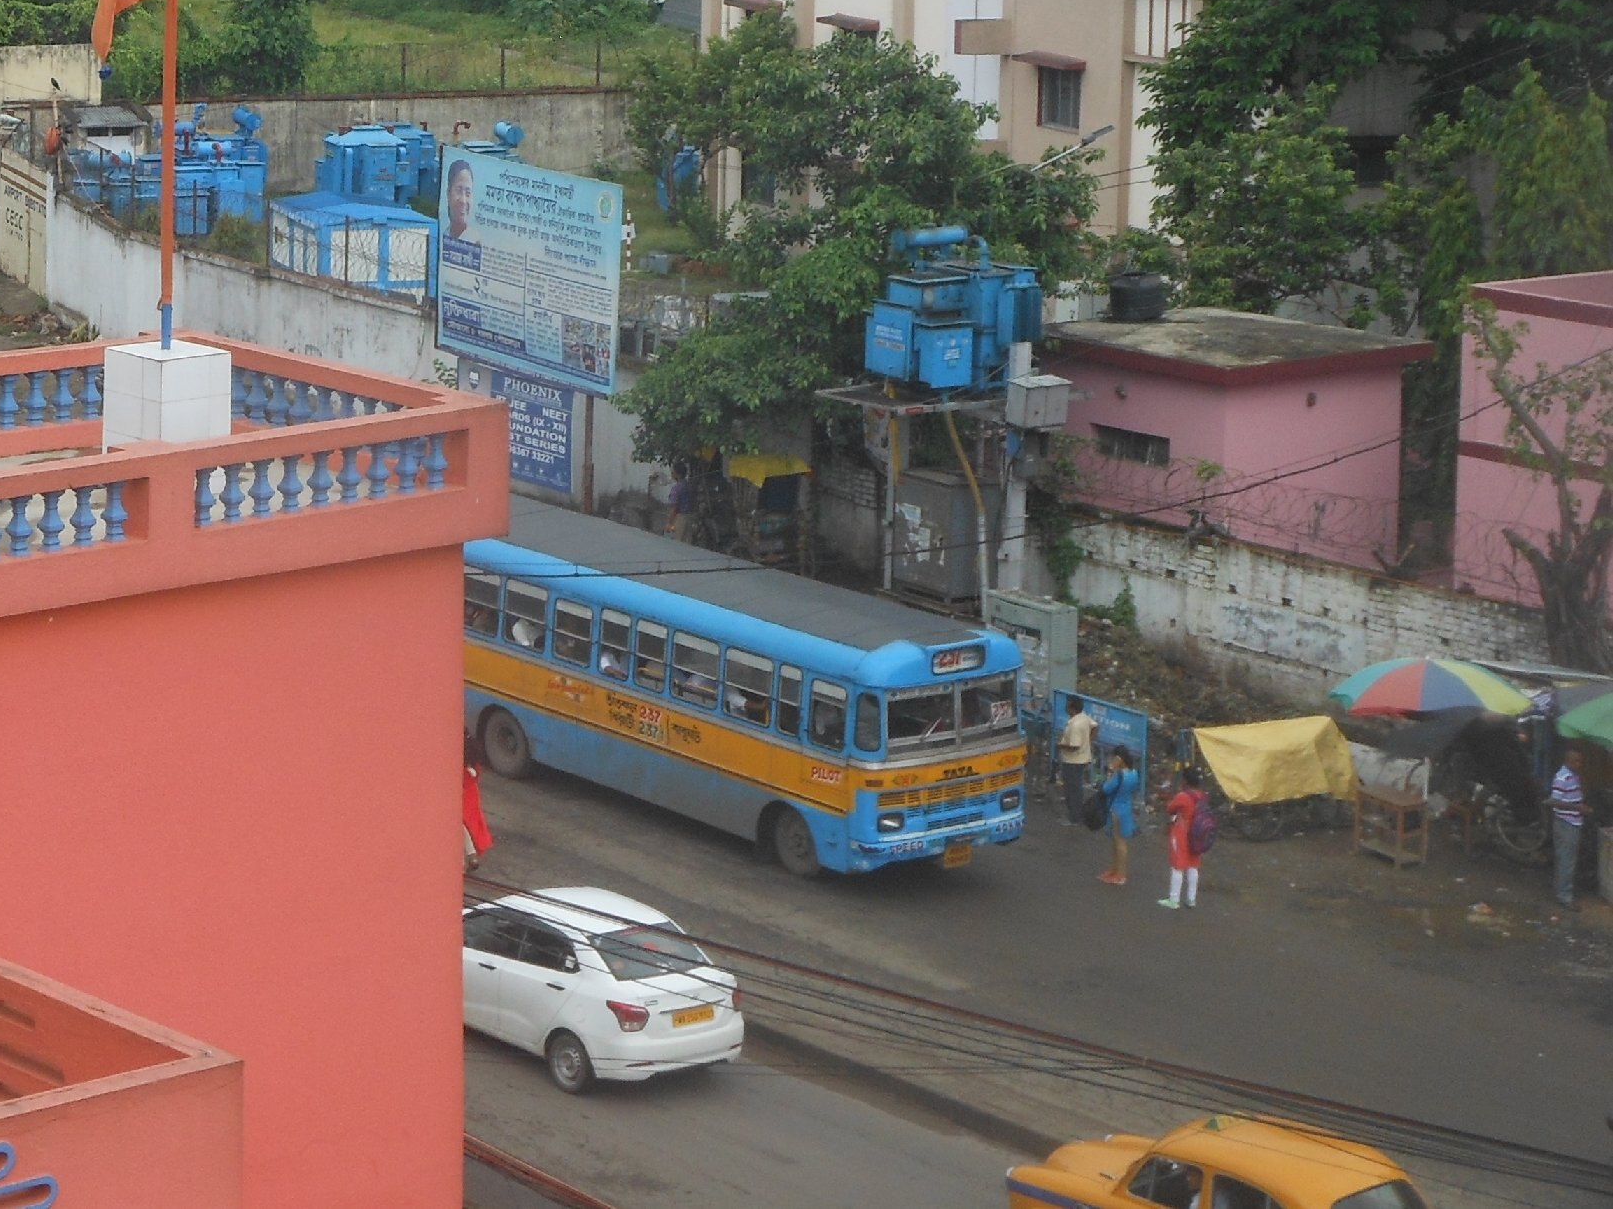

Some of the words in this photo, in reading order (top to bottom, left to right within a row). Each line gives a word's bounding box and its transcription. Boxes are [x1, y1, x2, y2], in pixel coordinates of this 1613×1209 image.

[504, 377, 562, 401] PHOENIX
[541, 406, 569, 422] NEET
[524, 435, 566, 455] SERIES
[639, 705, 661, 723] 237
[811, 766, 842, 783] PILOT
[943, 765, 975, 780] TATA
[889, 840, 925, 855] SPEED
